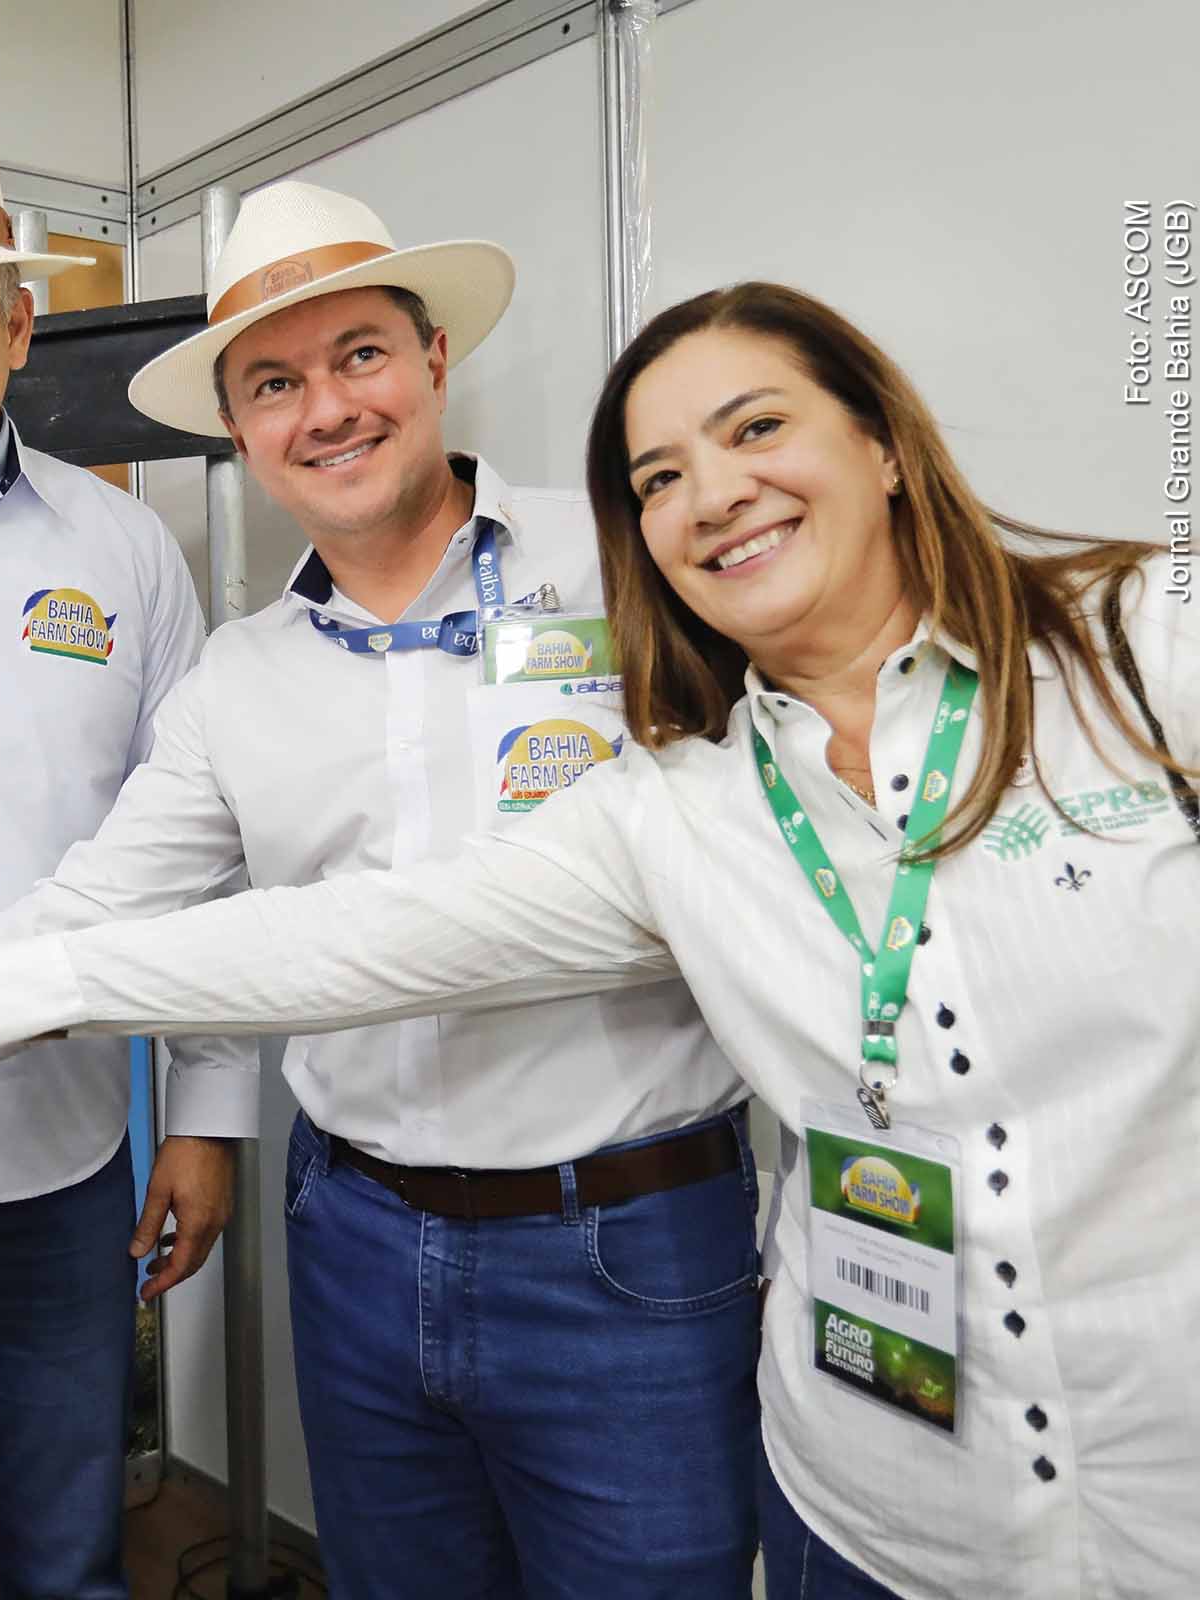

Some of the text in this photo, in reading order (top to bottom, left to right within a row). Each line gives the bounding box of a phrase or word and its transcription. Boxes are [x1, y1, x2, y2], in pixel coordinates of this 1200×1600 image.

[480, 565, 499, 602] aiba
[48, 600, 94, 624] BAHIA
[31, 620, 106, 650] FARM SHOW
[537, 642, 572, 655] BAHIA
[527, 655, 584, 669] FARM SHOW
[577, 679, 624, 694] aiba
[528, 735, 592, 760] BAHIA
[511, 762, 595, 788] FARM SH
[1056, 781, 1169, 818] SPRB
[861, 1168, 897, 1191] BAHIA
[851, 1185, 911, 1215] FARM SHOW
[825, 1313, 873, 1347] AGRO
[825, 1339, 874, 1373] FUTURO
